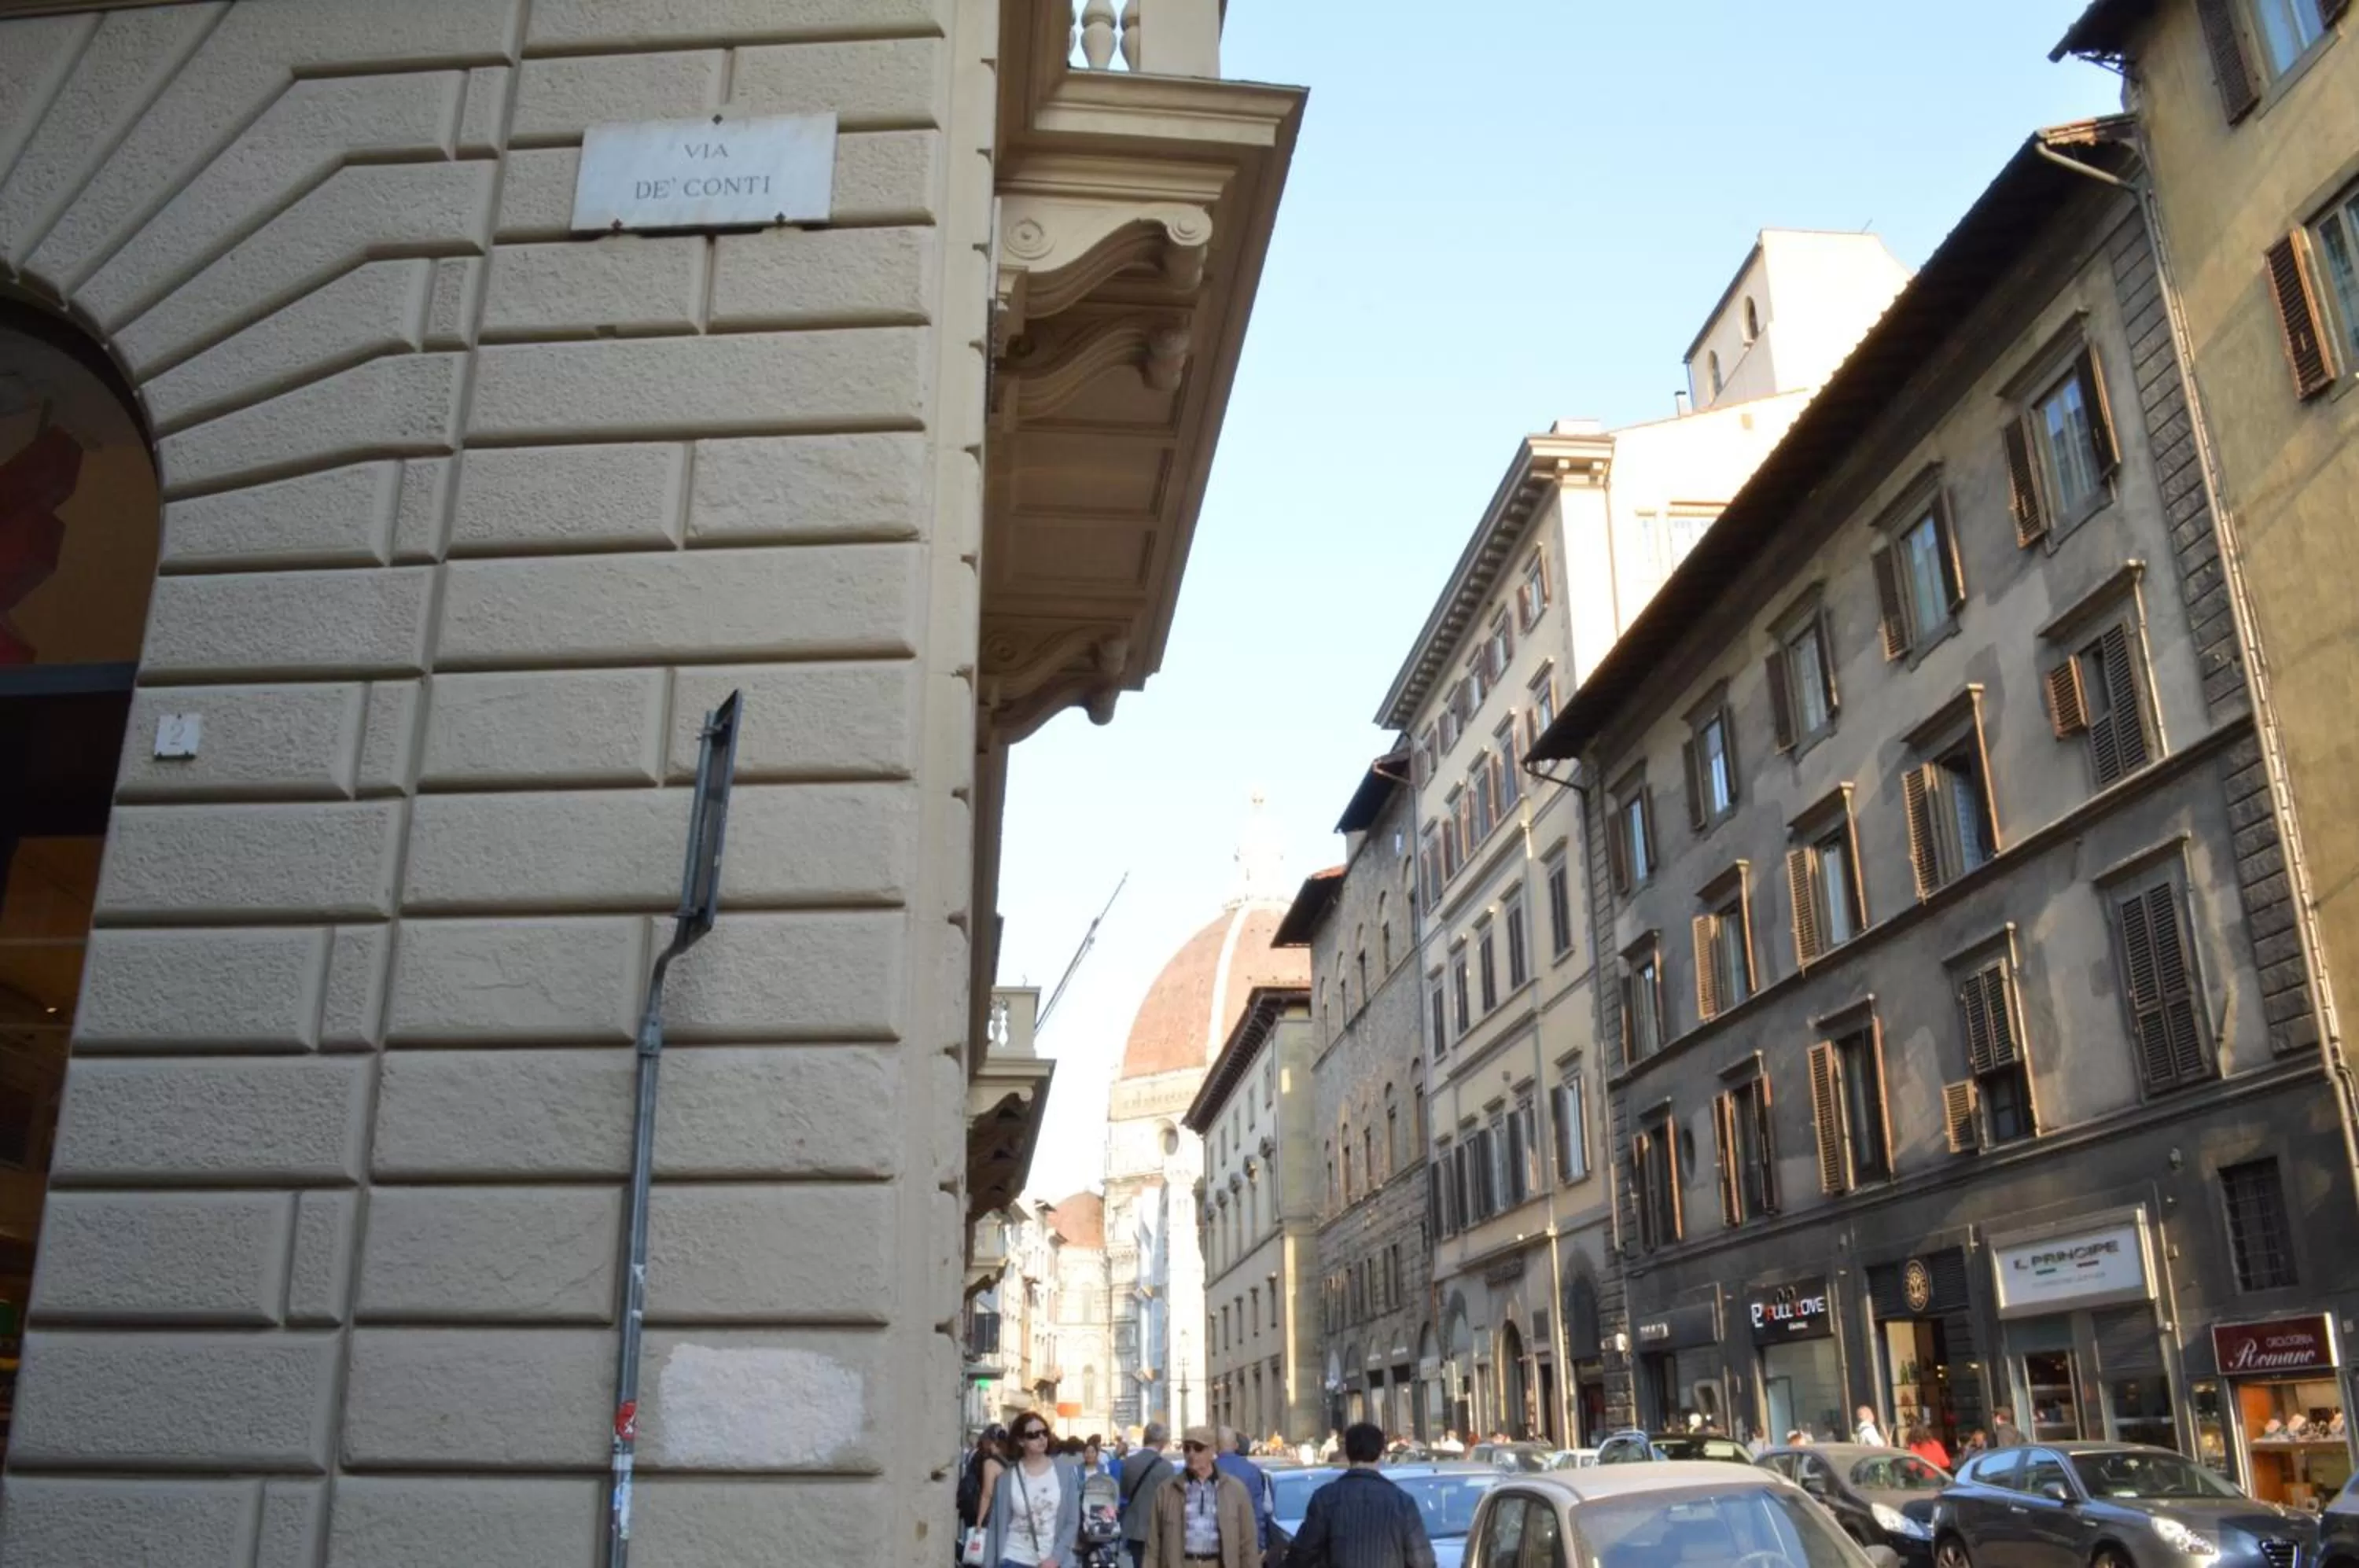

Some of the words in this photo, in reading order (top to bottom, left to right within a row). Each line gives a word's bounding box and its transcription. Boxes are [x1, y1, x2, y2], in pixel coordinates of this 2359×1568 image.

[684, 143, 728, 160] VIA
[635, 178, 677, 200] DE'
[683, 175, 771, 197] CONTI
[169, 722, 186, 746] 2
[2031, 1239, 2120, 1267] PRINCIPE
[1796, 1296, 1826, 1317] LOVE
[2228, 1338, 2316, 1368] Romano
